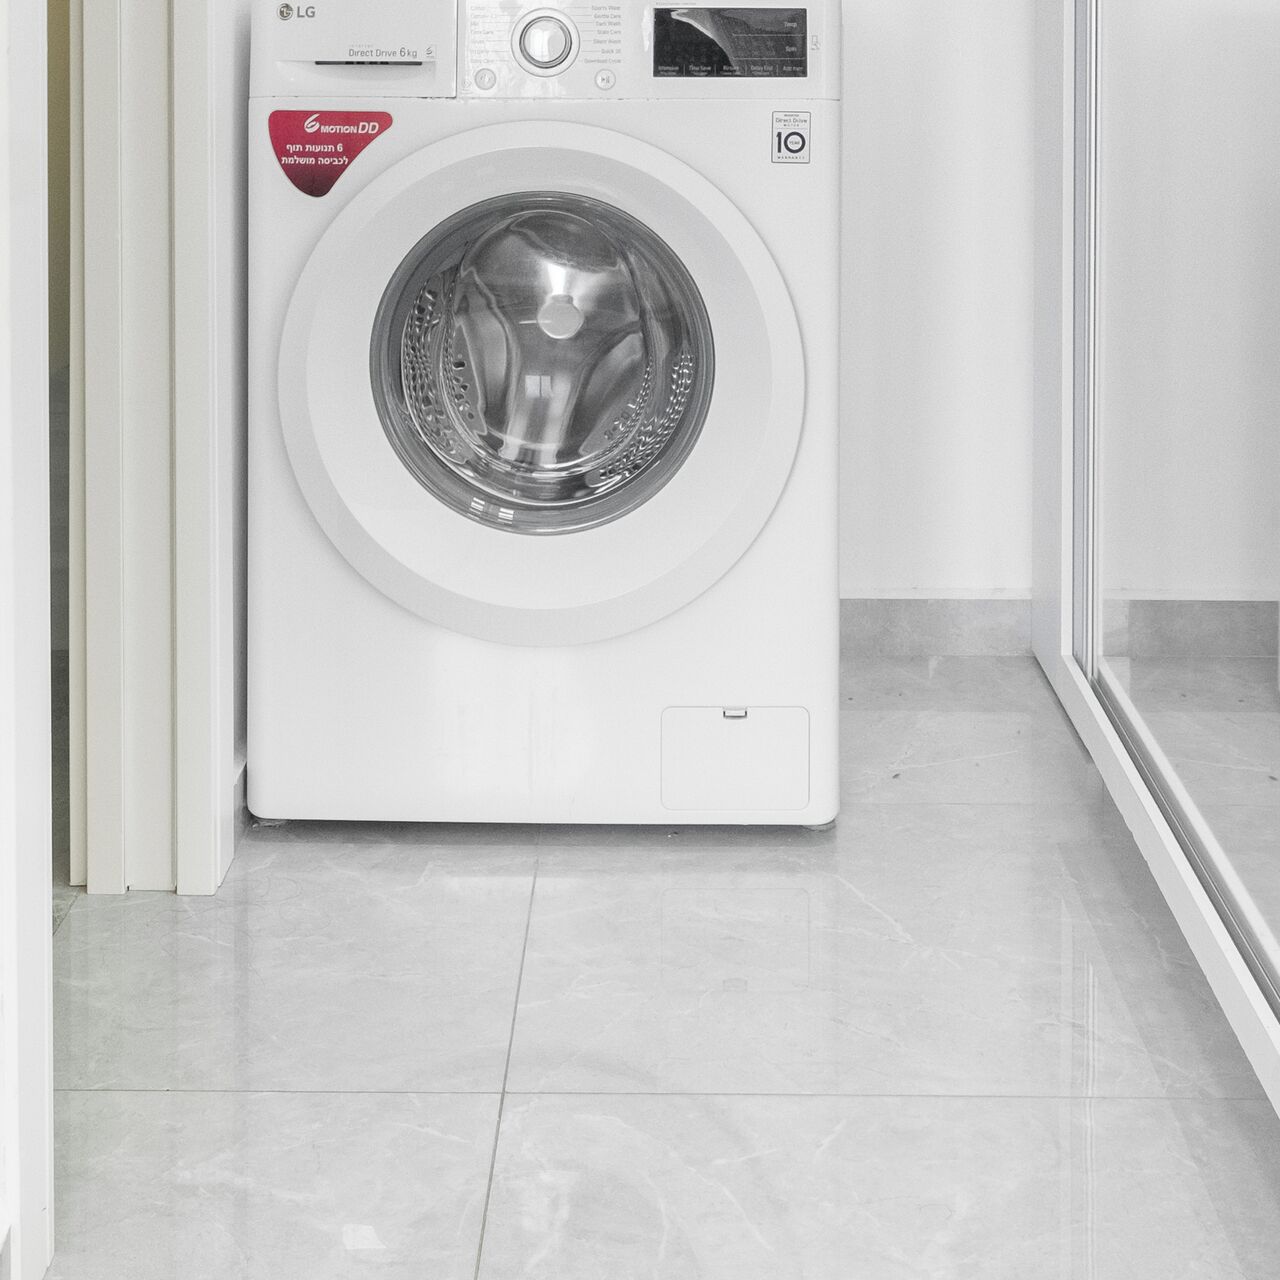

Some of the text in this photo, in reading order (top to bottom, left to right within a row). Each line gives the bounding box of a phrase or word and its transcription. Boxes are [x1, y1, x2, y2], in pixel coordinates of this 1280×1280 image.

[297, 6, 316, 18] LG
[349, 49, 373, 58] Direct
[376, 49, 397, 58] Drive
[320, 125, 357, 134] MOTION
[358, 122, 379, 134] DD
[776, 131, 806, 154] 10
[286, 144, 343, 153] 6 תנועות תוף
[281, 156, 348, 165] לכביסה מושלמת
